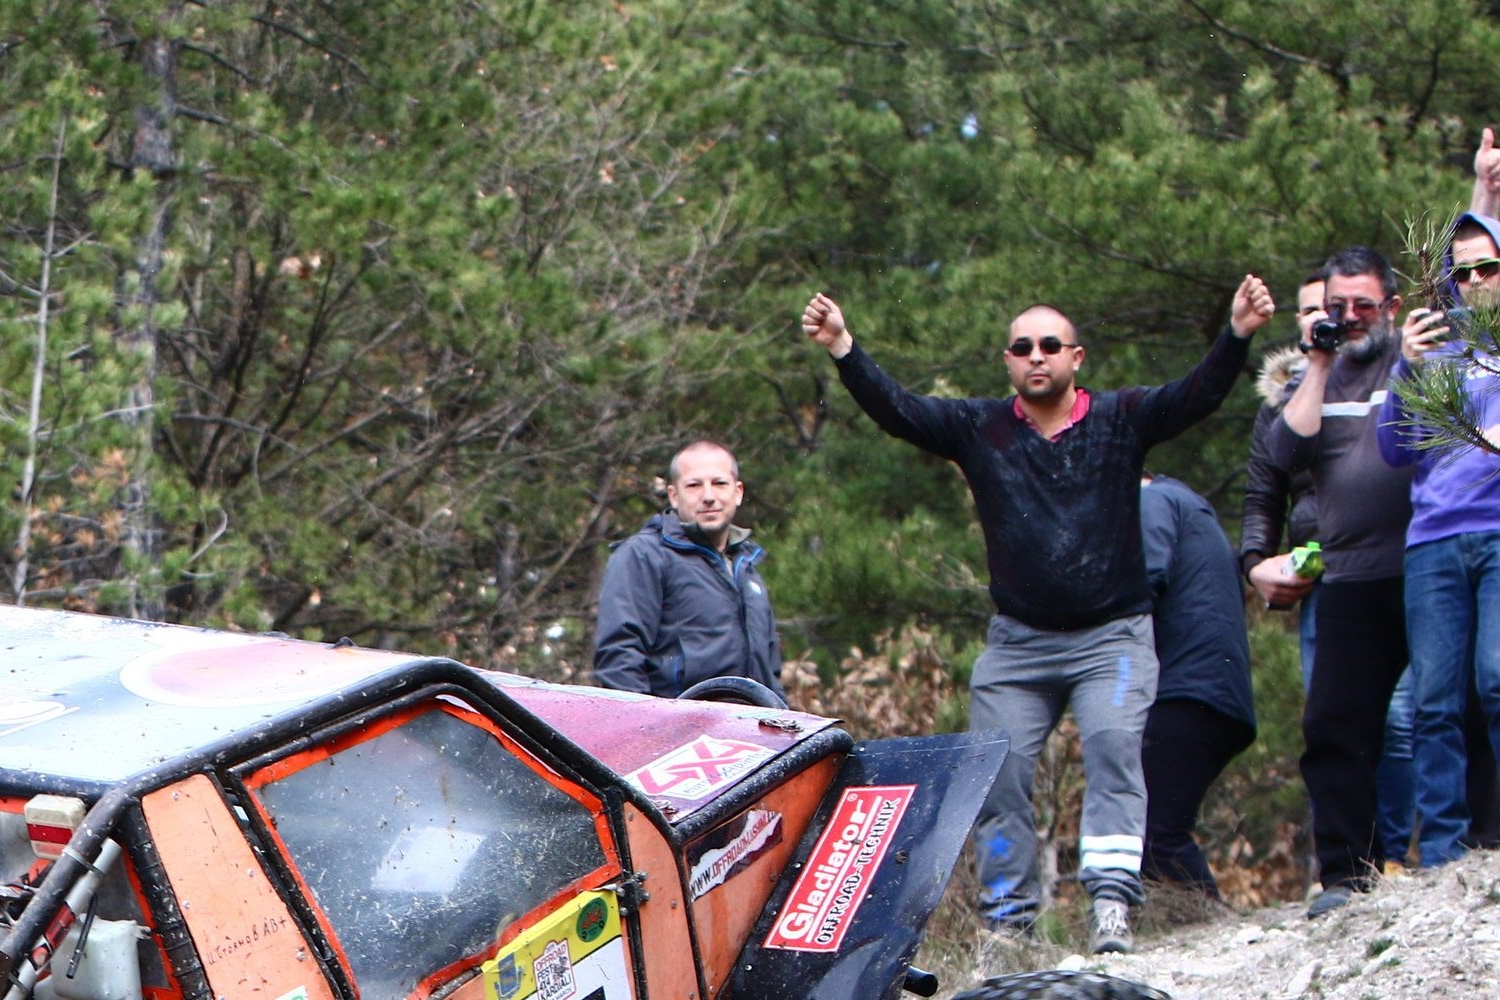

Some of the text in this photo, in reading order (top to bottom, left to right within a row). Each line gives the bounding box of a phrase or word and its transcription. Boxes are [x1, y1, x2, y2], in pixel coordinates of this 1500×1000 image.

[778, 798, 867, 940] Gladiator
[815, 796, 902, 945] OFFROAD-TECHNIK
[535, 943, 567, 972] OFFROAD
